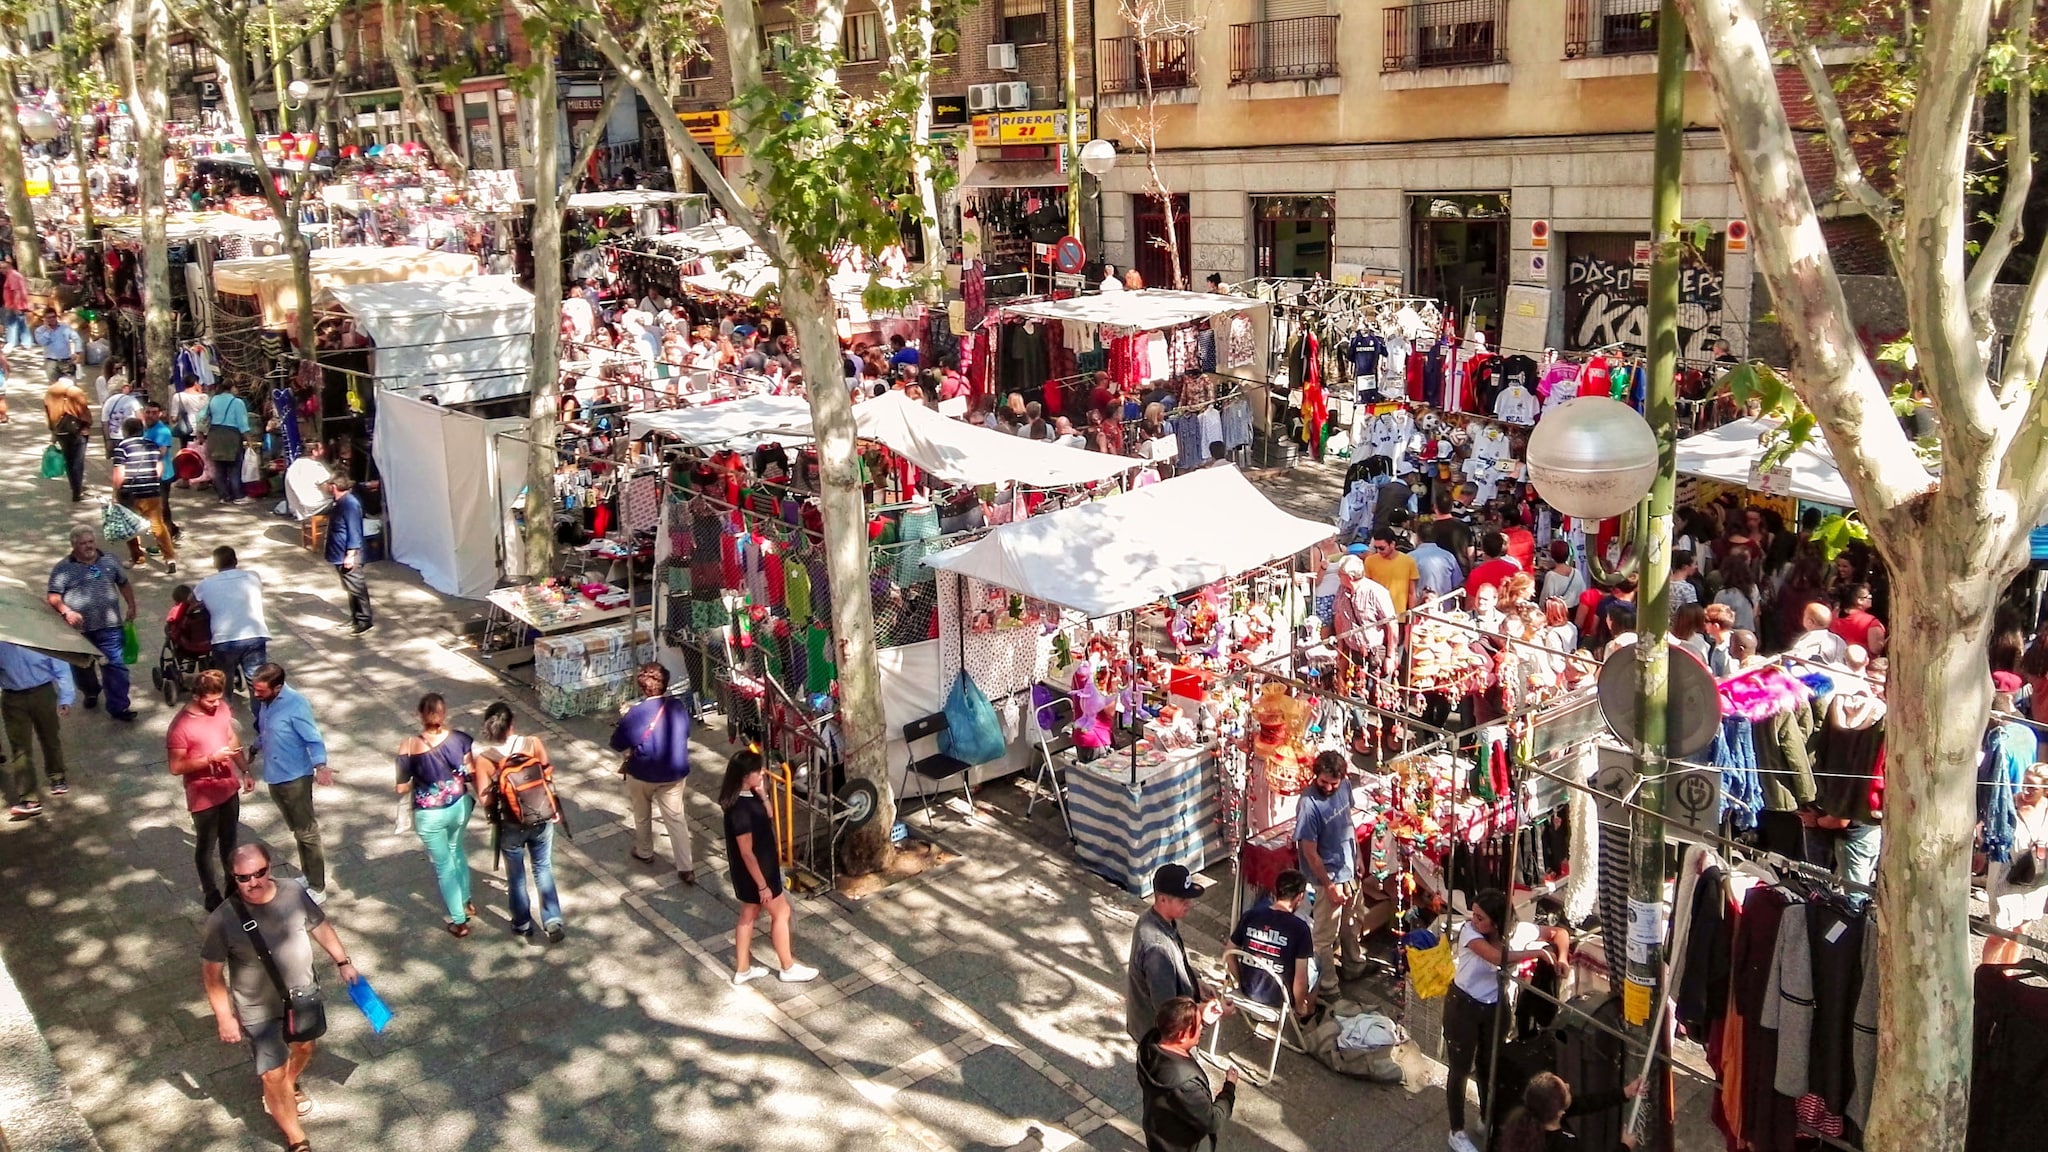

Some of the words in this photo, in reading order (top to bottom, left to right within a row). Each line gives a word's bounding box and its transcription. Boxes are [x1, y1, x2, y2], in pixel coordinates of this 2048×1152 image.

[567, 100, 602, 109] MUEBLES
[1002, 115, 1052, 125] RIBERA
[1018, 126, 1036, 136] 21
[1680, 268, 1723, 297] EPS
[1506, 415, 1525, 424] REAL
